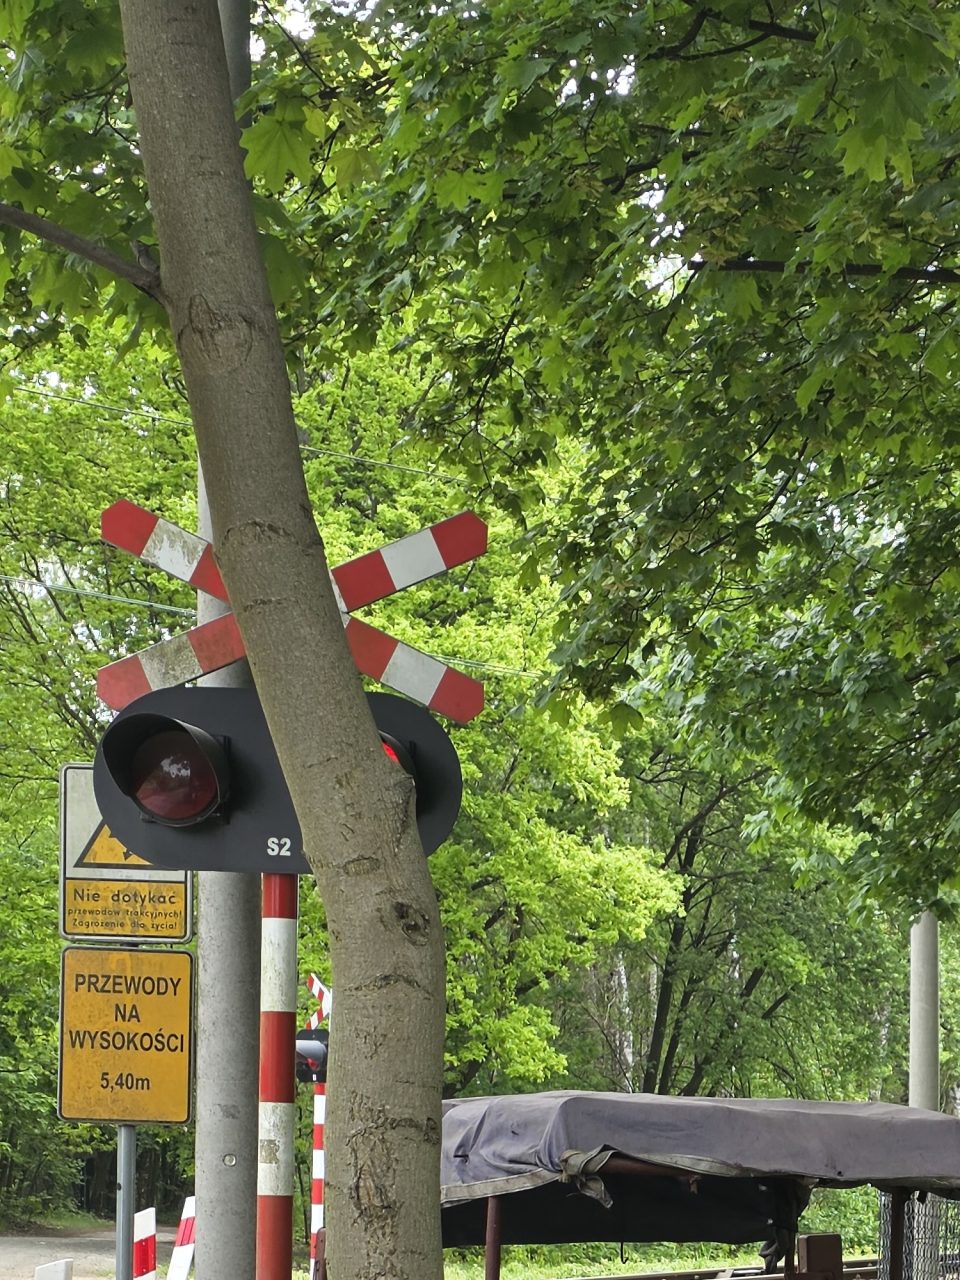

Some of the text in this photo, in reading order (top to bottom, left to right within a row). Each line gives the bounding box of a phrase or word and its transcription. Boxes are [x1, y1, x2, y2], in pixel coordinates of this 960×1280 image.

[267, 837, 291, 857] S2
[73, 888, 177, 906] Nie dotykać
[74, 973, 182, 997] PRZEWODY
[114, 1003, 141, 1023] NA
[69, 1028, 184, 1053] WYSOKOŚCI
[100, 1072, 151, 1092] 5,40m
